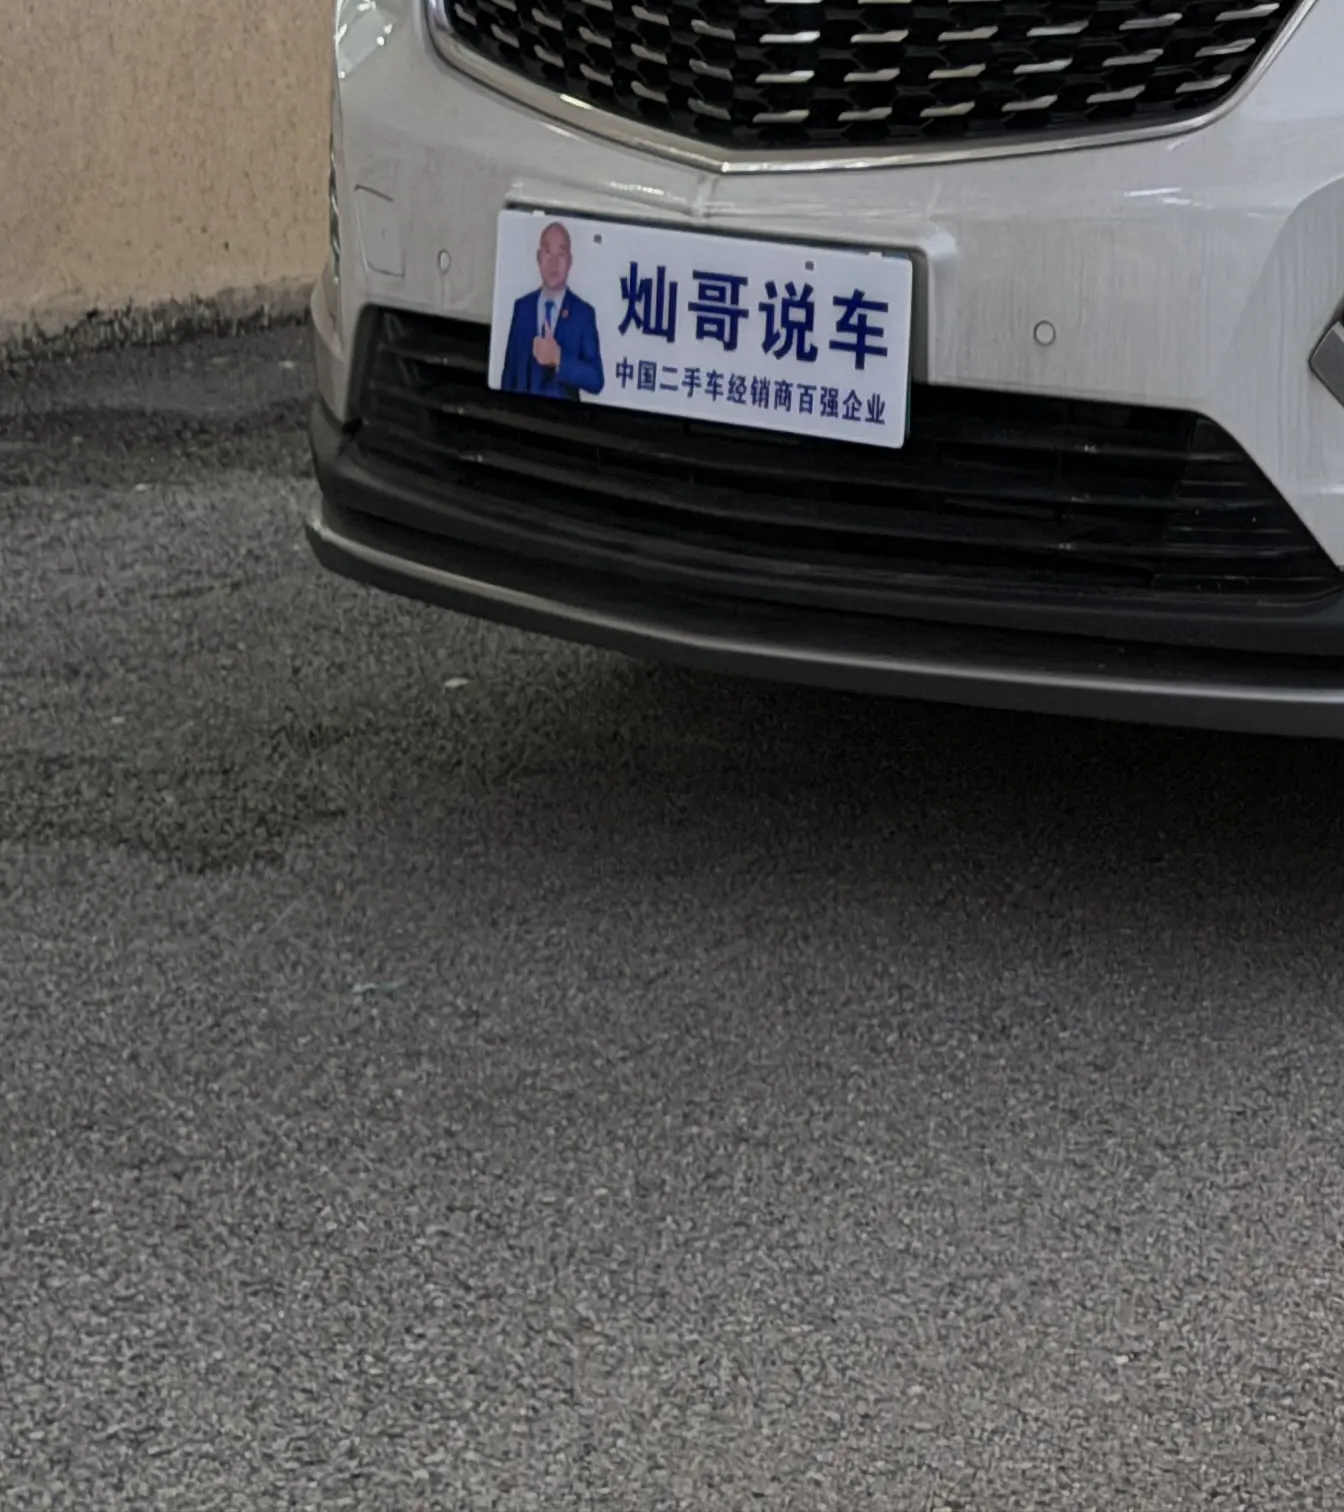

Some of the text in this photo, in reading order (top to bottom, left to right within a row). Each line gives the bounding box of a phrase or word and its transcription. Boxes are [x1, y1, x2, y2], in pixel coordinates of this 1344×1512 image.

[618, 261, 889, 370] 灿哥说车
[615, 356, 887, 425] 中国二手车经销商百强企业
